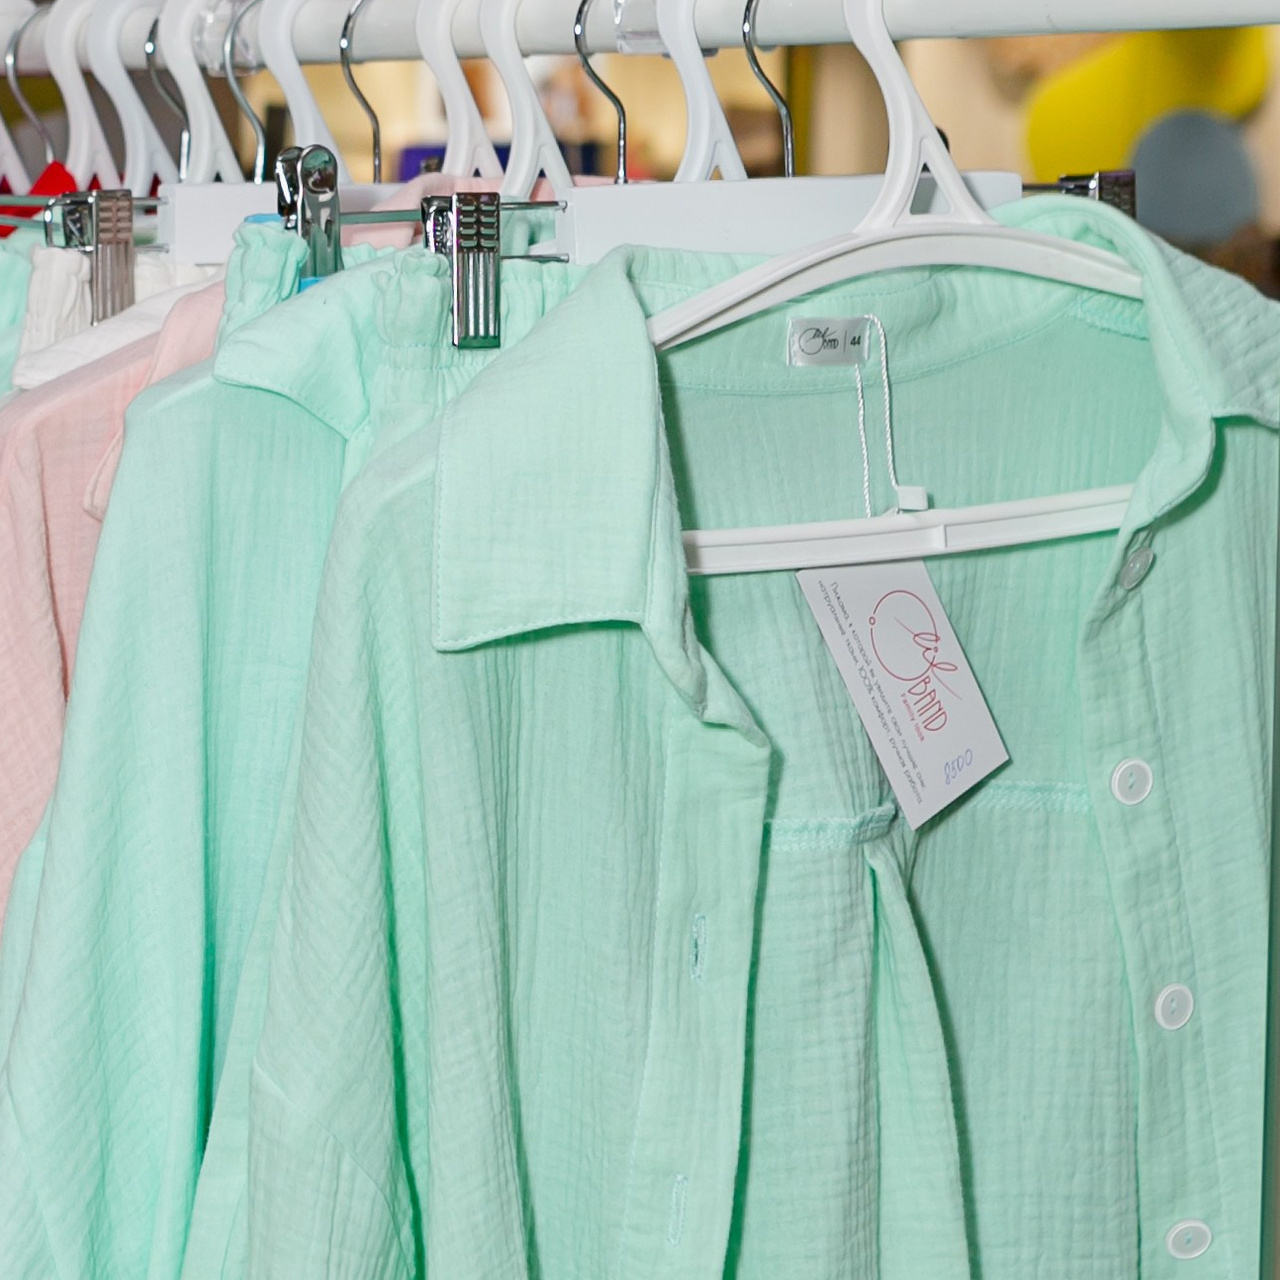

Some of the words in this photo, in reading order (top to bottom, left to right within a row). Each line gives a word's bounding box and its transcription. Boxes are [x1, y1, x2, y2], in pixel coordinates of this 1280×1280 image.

[857, 664, 875, 694] 100%
[900, 692, 916, 722] Family
[914, 723, 926, 742] look
[908, 676, 948, 732] BAND
[944, 748, 973, 785] 8500
